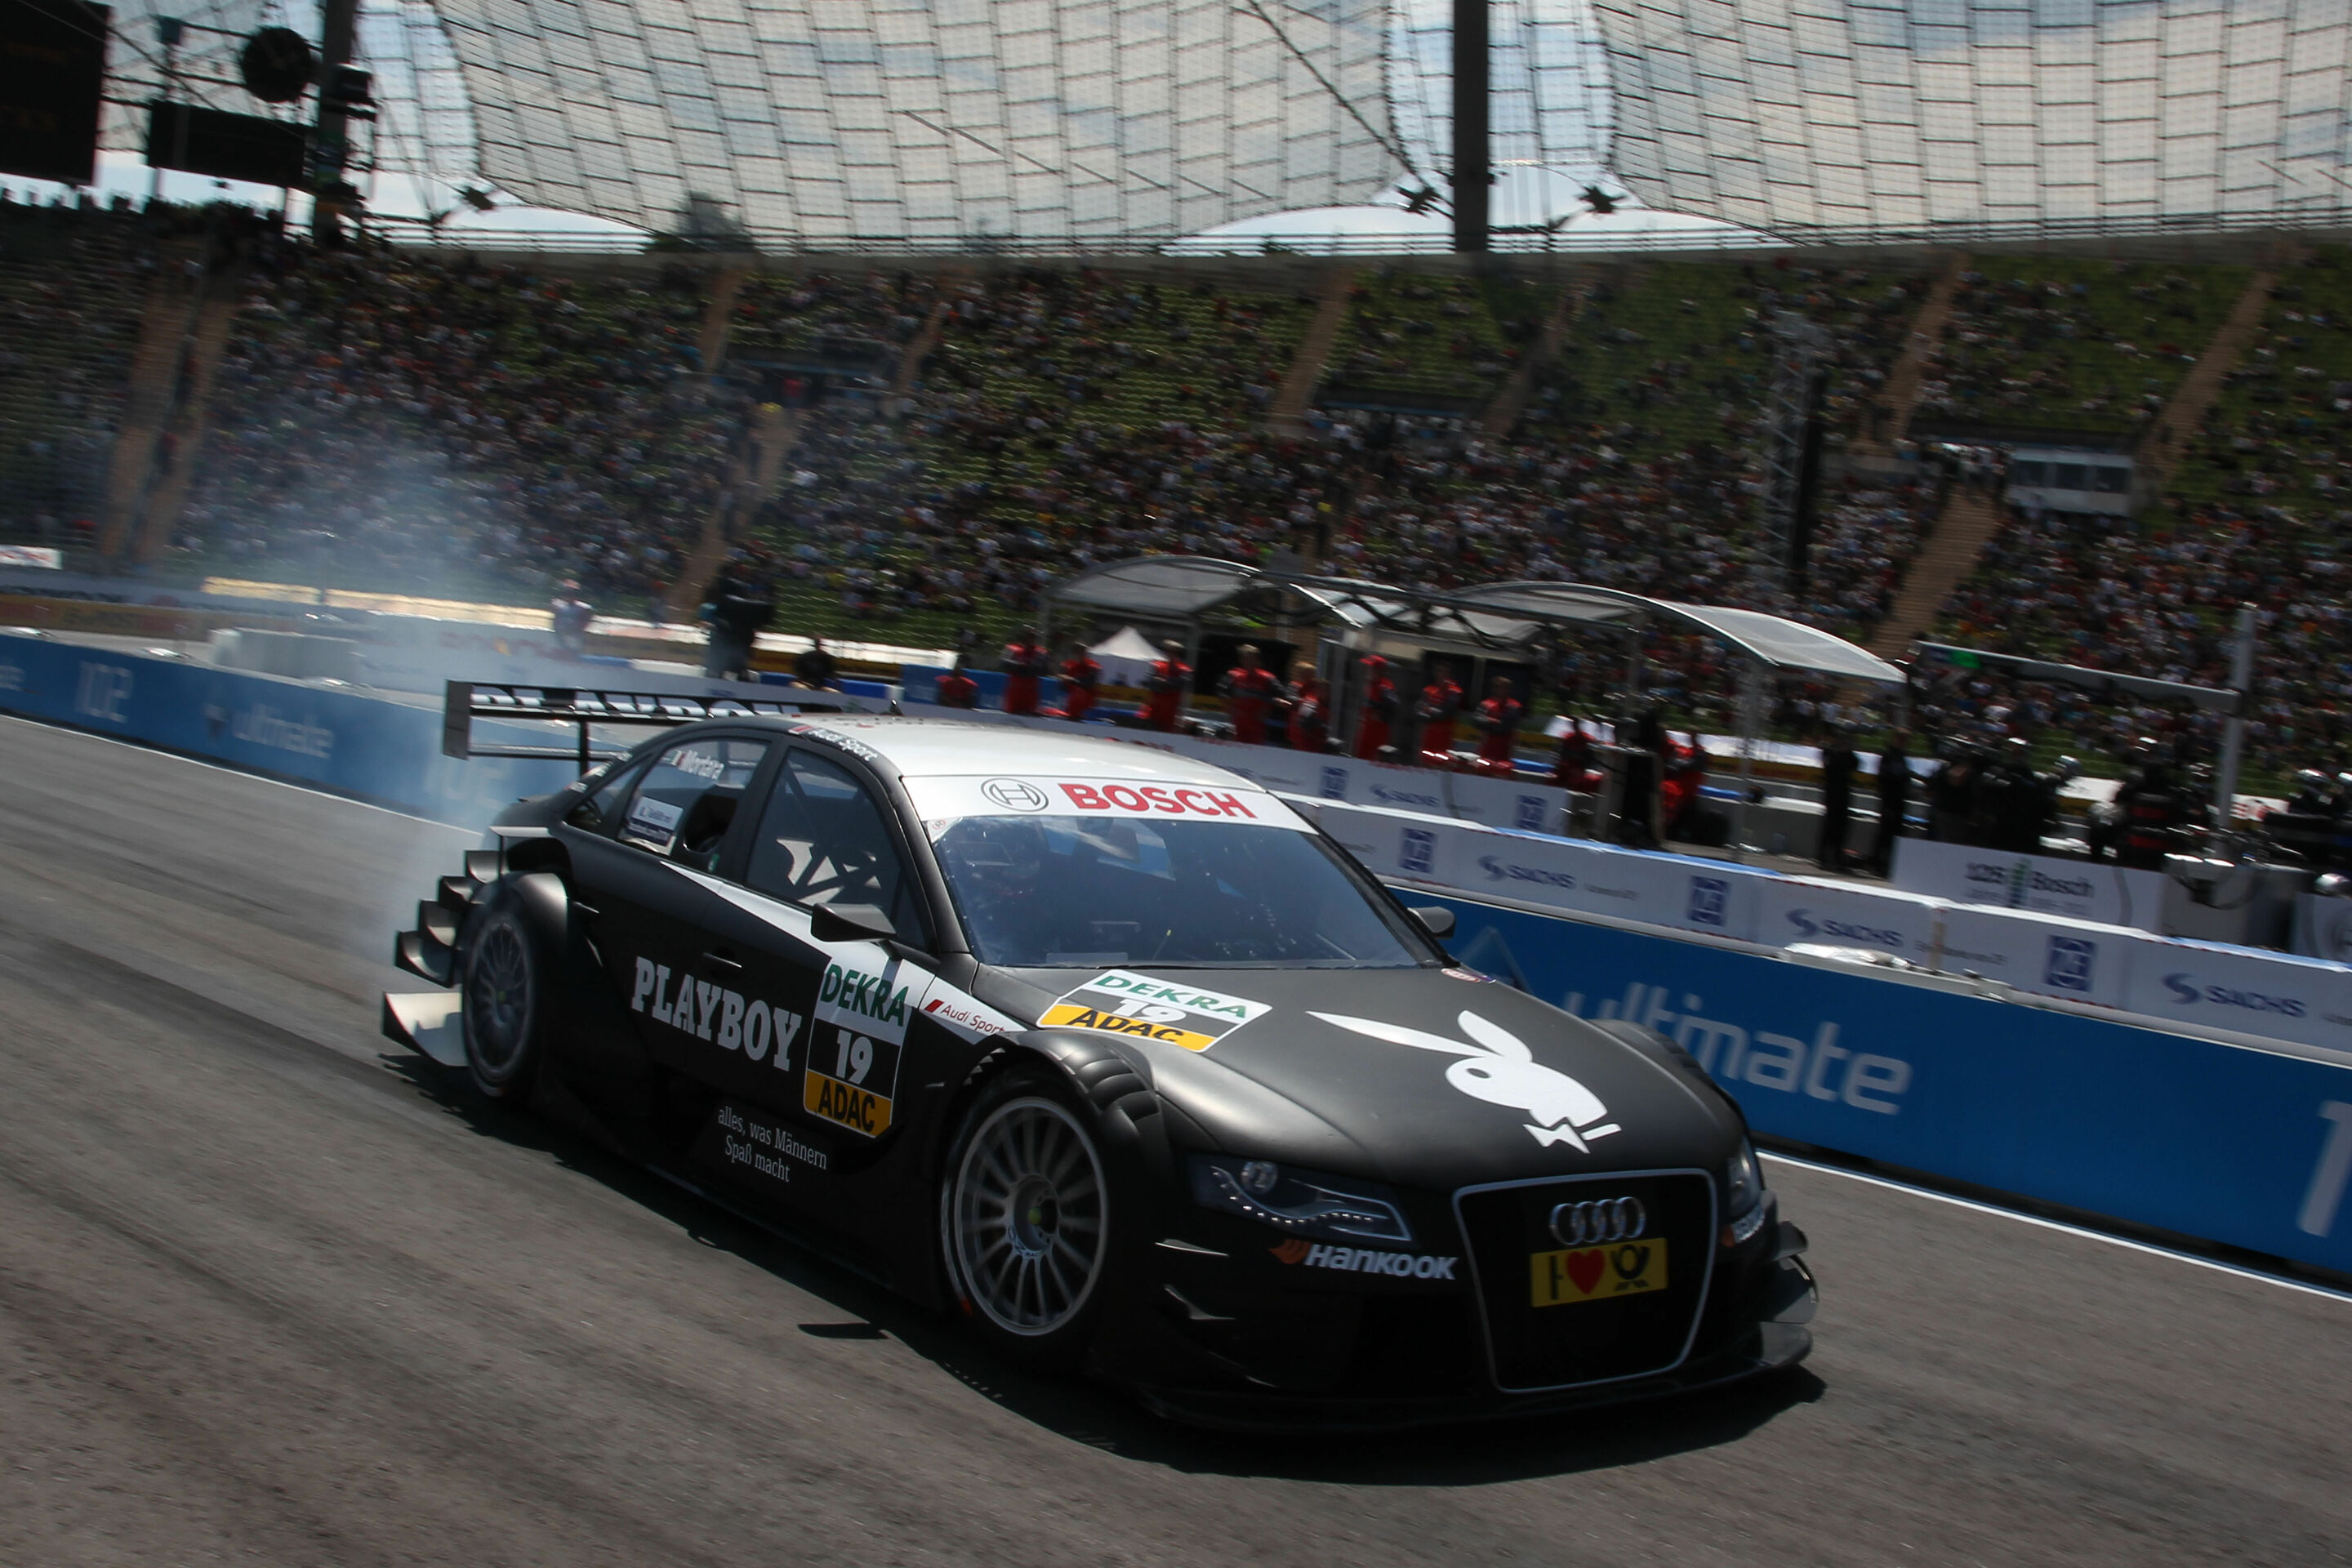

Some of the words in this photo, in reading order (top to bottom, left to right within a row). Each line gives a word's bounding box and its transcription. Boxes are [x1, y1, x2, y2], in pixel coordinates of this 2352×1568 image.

[679, 750, 724, 780] Mortara
[838, 738, 878, 761] Sport
[1058, 783, 1258, 819] BOSCH
[1507, 864, 1577, 889] SACHS
[2029, 871, 2095, 898] Bosch
[1822, 919, 1904, 947] SACHS
[820, 964, 910, 1027] DEKRA
[1093, 975, 1248, 1018] DEKRA
[1110, 998, 1187, 1024] 19
[2206, 985, 2307, 1018] SACHS
[631, 956, 802, 1071] PLAYBOY
[941, 1005, 969, 1022] Audi
[1065, 1009, 1187, 1042] ADAC
[835, 1029, 874, 1085] 19
[817, 1080, 875, 1133] ADAC
[718, 1107, 746, 1135] alles,
[750, 1122, 772, 1145] was
[776, 1128, 827, 1169] Männern
[725, 1136, 751, 1164] Spaß
[755, 1152, 790, 1182] macht
